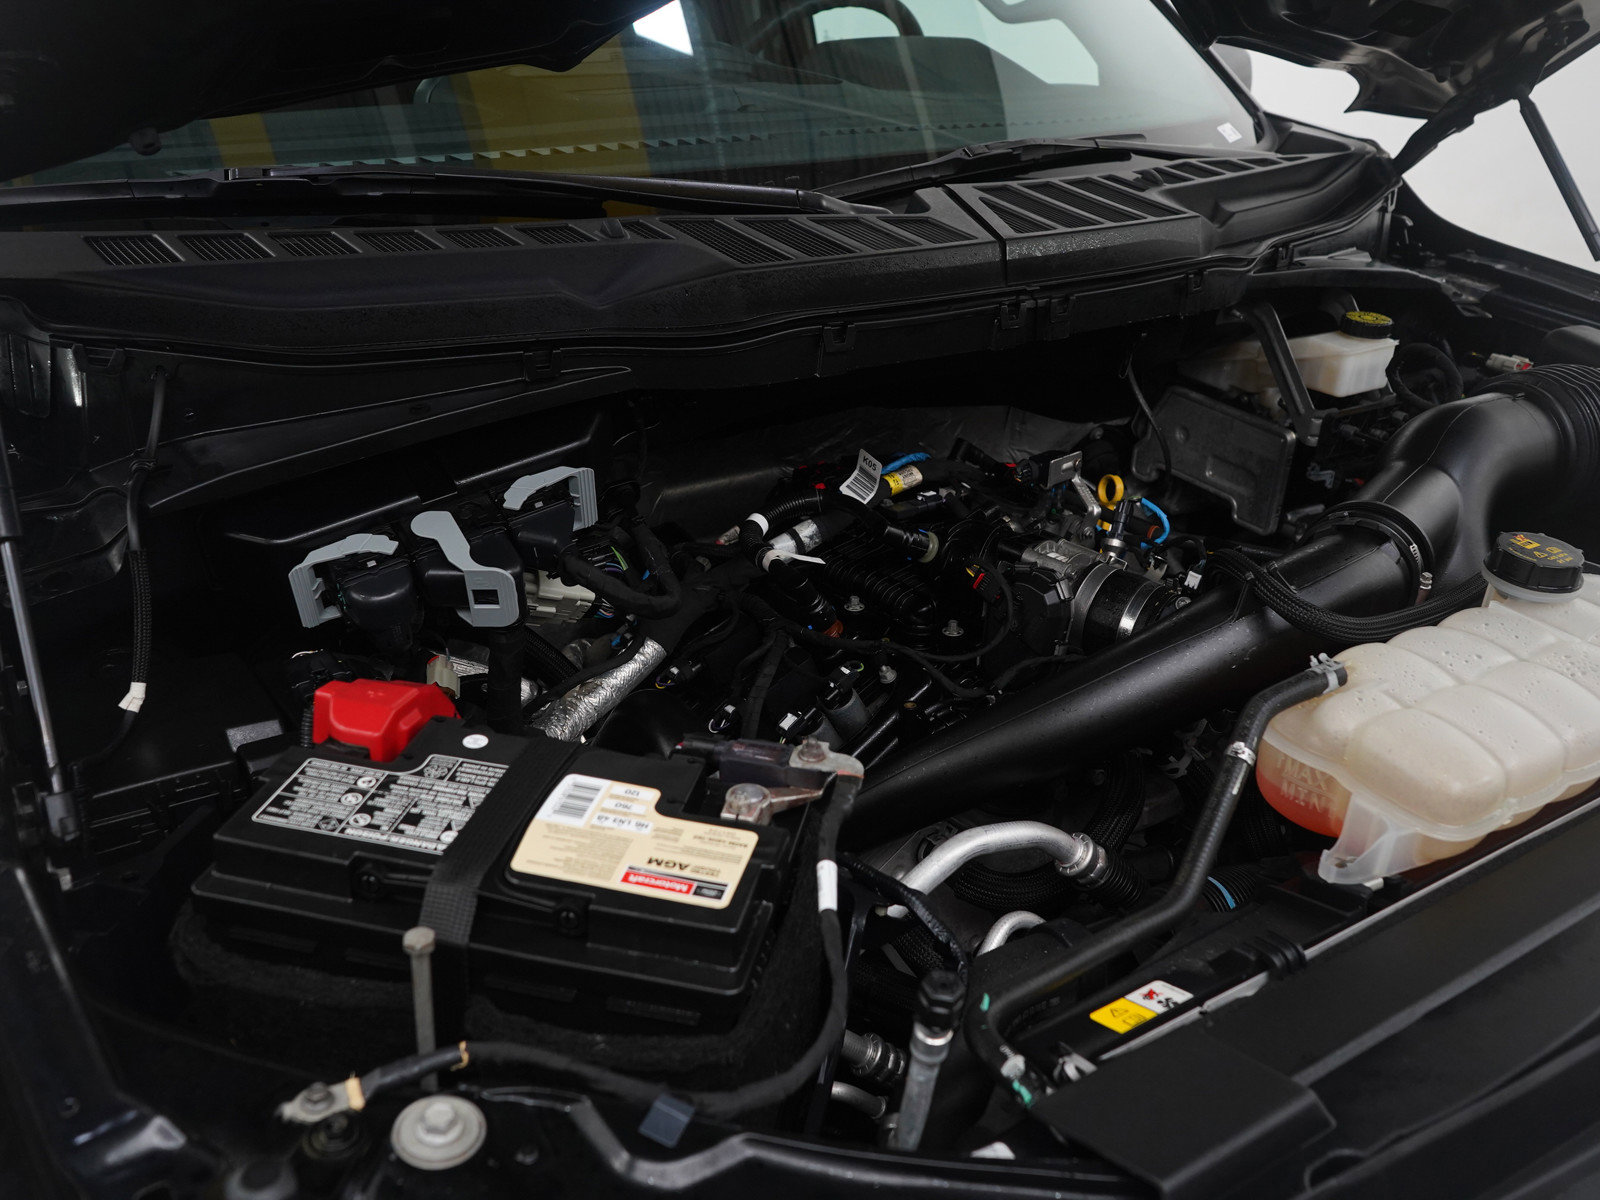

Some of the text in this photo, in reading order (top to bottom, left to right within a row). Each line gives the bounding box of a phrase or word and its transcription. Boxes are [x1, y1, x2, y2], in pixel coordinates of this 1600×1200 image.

[863, 456, 877, 471] K05
[1281, 759, 1328, 792] MAX
[1280, 779, 1328, 813] MIN
[647, 856, 690, 871] AGM
[628, 873, 689, 893] Motorcraft
